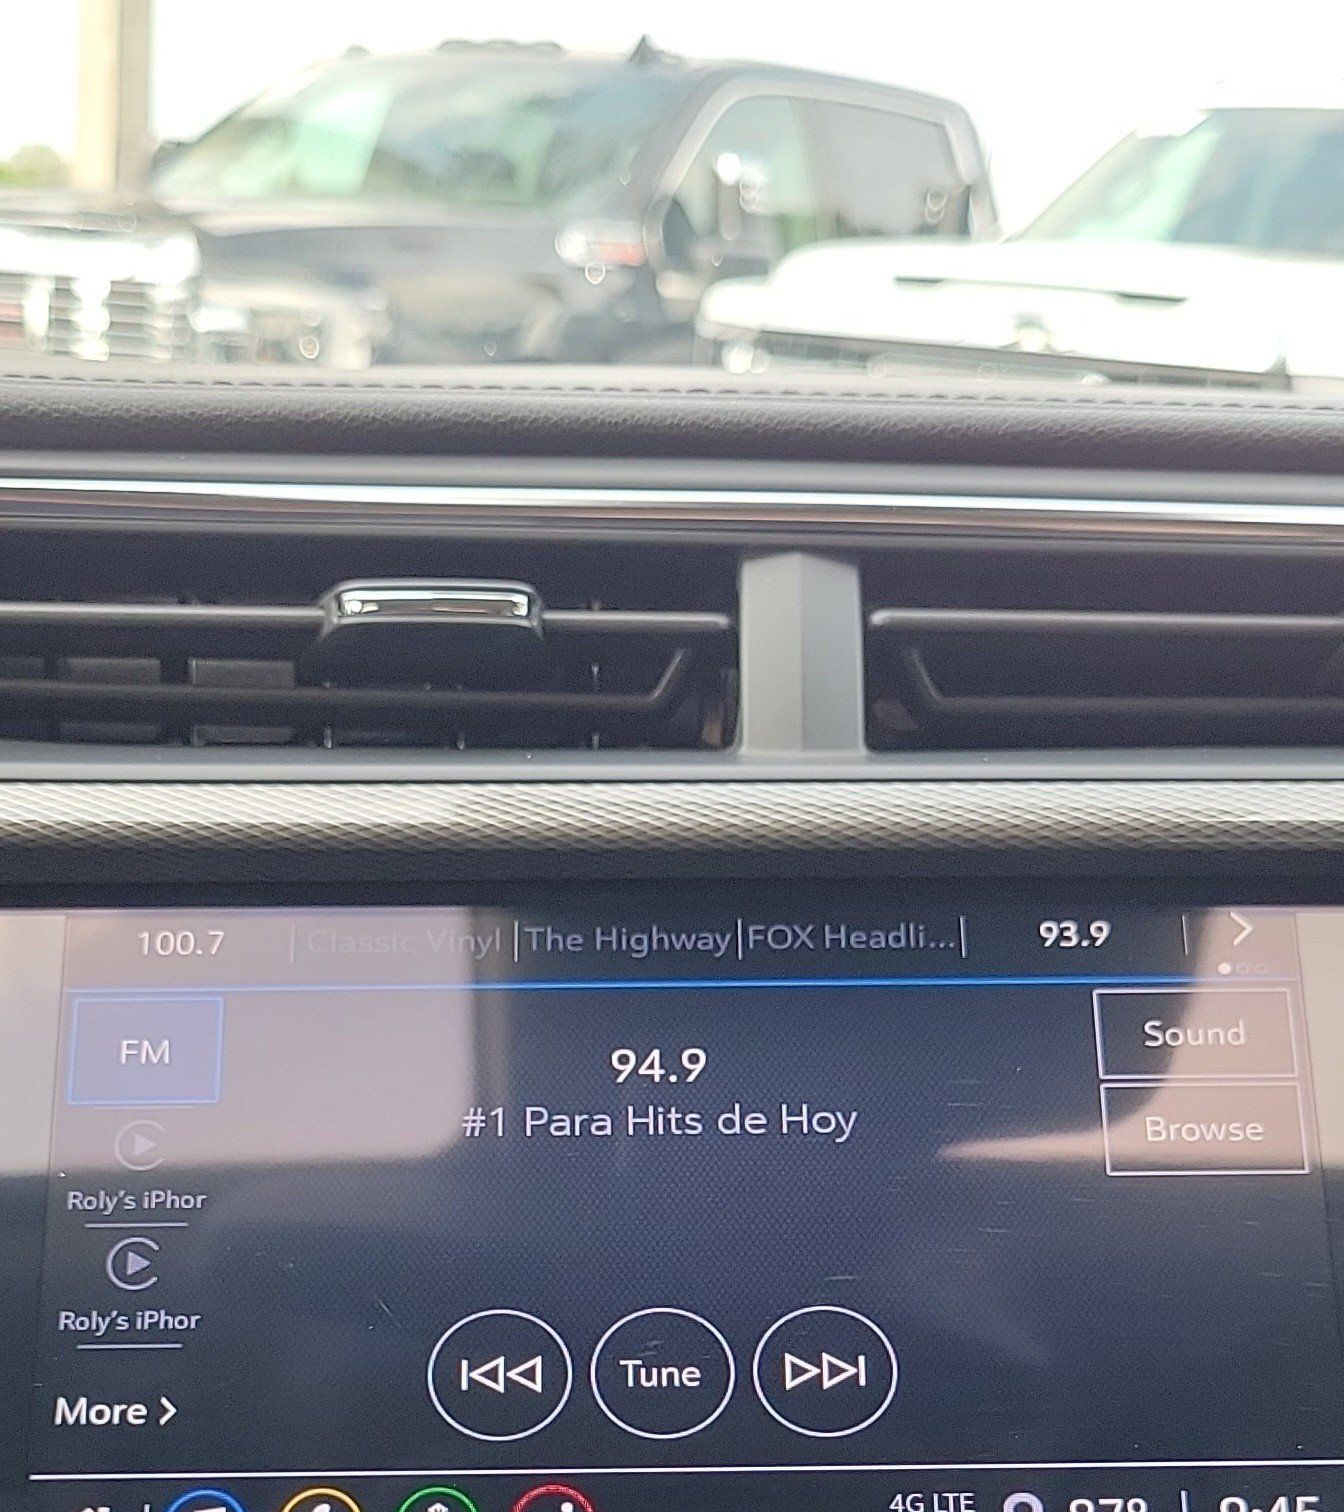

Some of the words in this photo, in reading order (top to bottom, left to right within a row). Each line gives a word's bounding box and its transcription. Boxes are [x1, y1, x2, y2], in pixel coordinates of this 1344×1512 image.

[139, 930, 225, 956] 100.7
[523, 926, 583, 952] The
[595, 925, 732, 958] Highway
[748, 924, 814, 950] FOX
[1039, 920, 1110, 947] 93.9
[1145, 1019, 1246, 1046] Sound
[120, 1039, 170, 1064] FM
[611, 1048, 707, 1083] 94.9
[461, 1106, 506, 1137] #1
[525, 1106, 612, 1137] Para
[627, 1105, 703, 1136] Hits
[717, 1103, 767, 1135] de
[781, 1103, 858, 1143] Hoy
[1145, 1116, 1264, 1142] Browse
[67, 1190, 136, 1215] Roly's
[58, 1310, 129, 1336] Roly's
[619, 1359, 701, 1388] Tune
[55, 1396, 148, 1425] More
